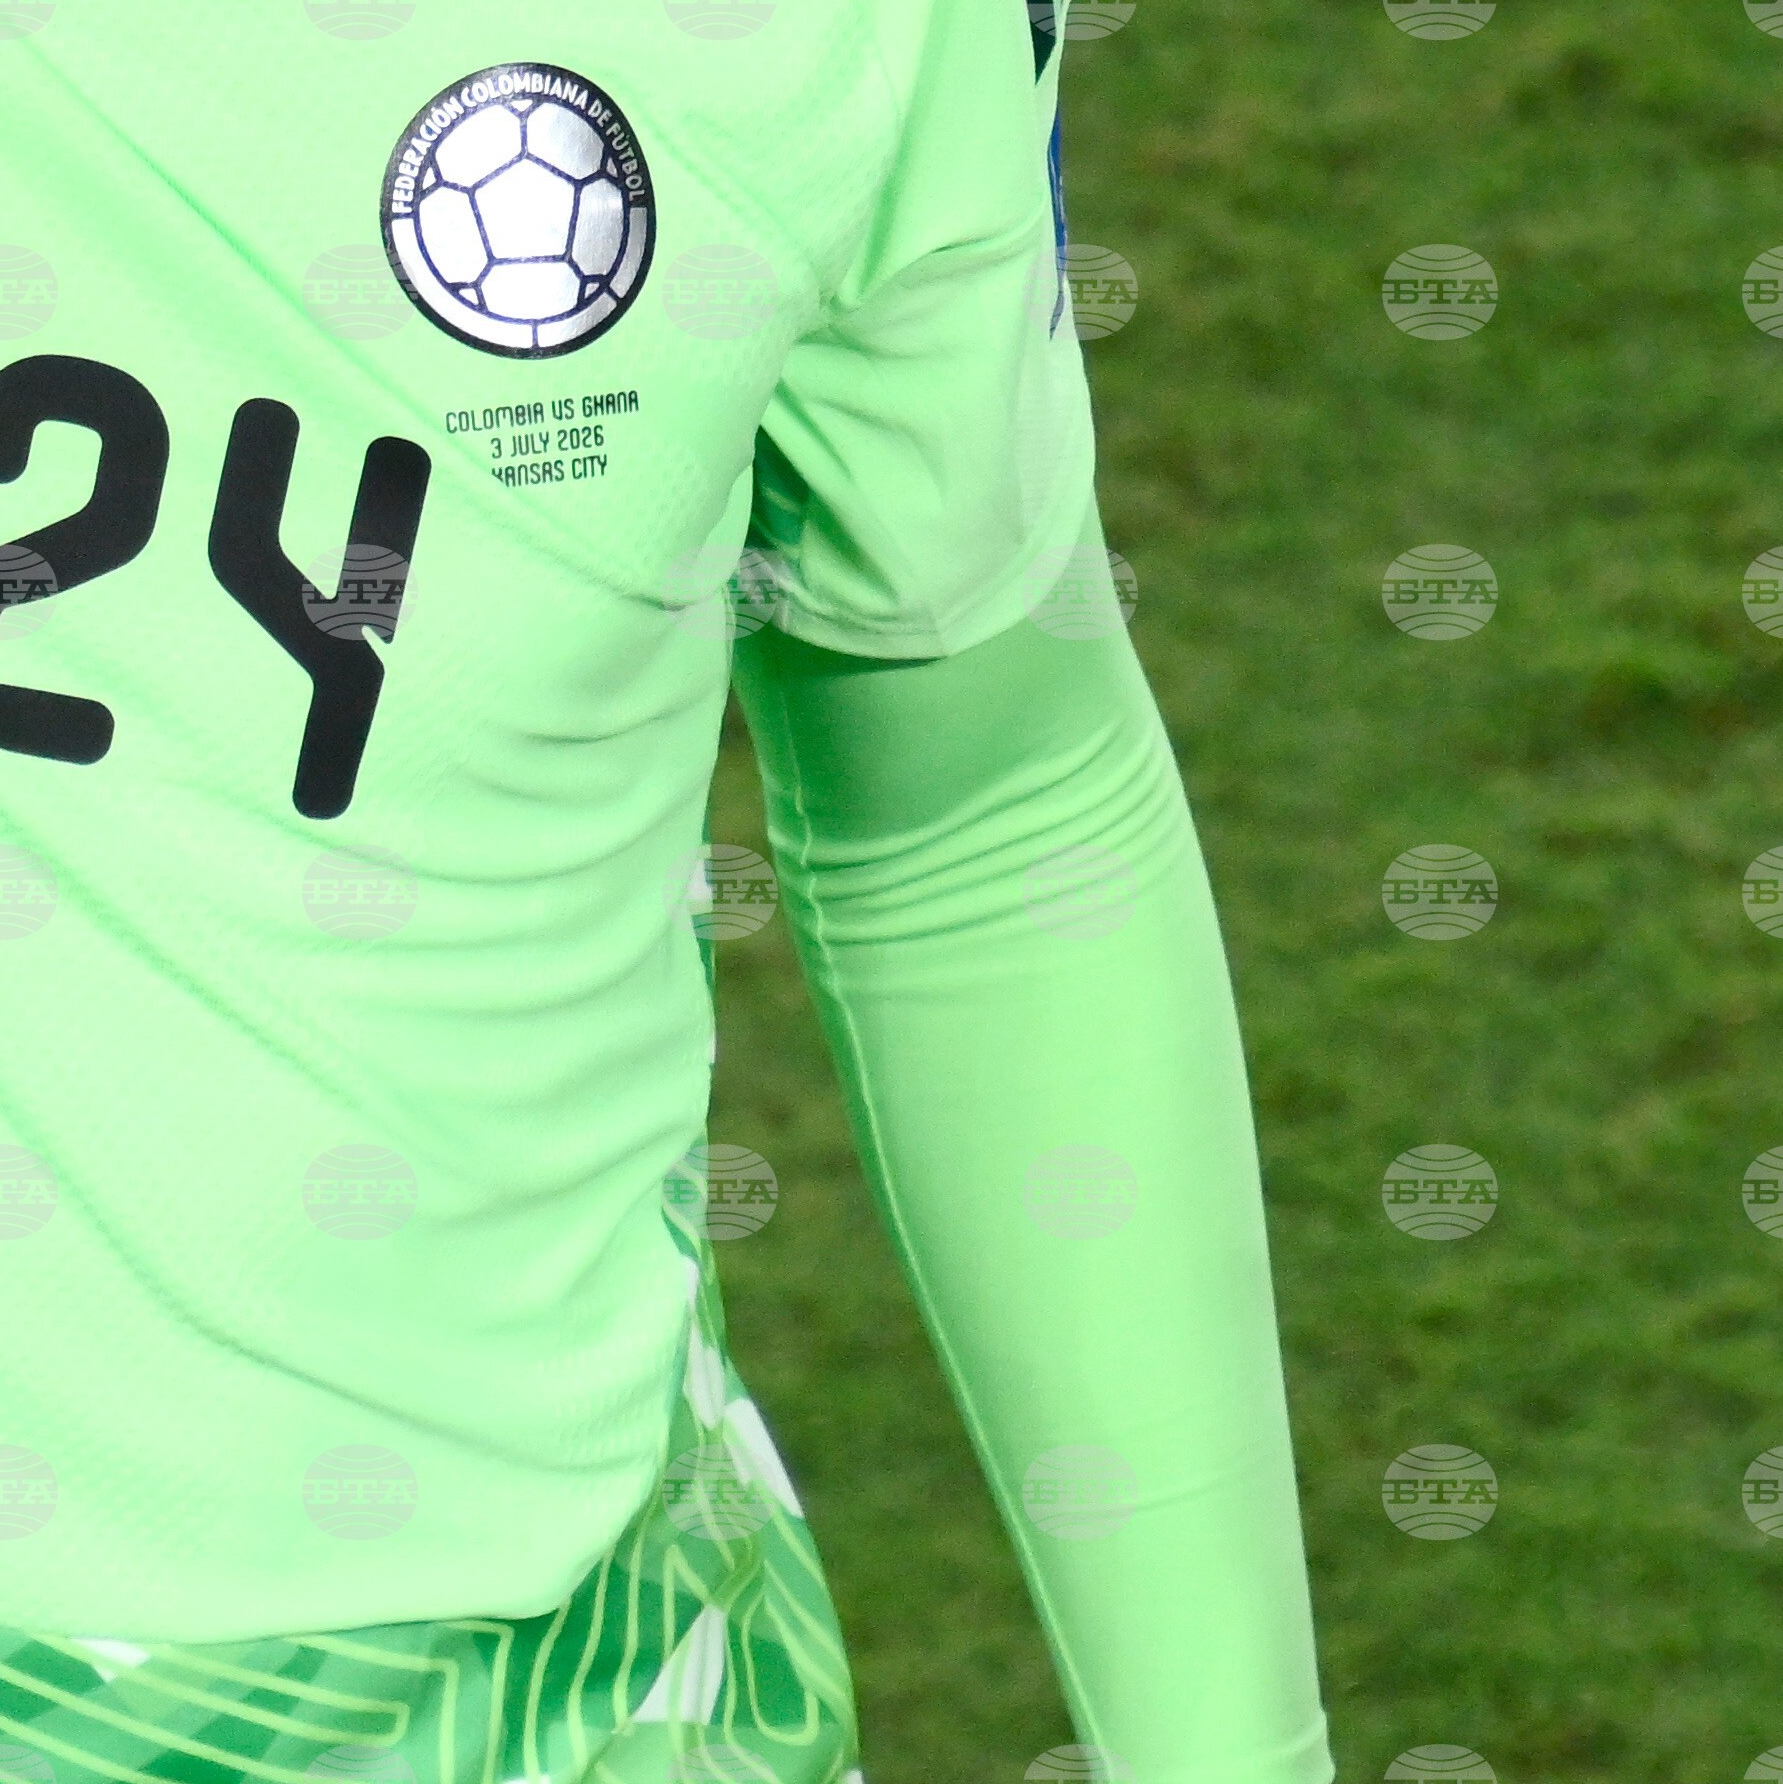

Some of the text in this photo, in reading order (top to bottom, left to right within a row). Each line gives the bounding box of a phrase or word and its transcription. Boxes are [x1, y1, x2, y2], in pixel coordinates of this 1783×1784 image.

[391, 72, 645, 214] FEDERACIÓN COLOMBIANA DE FÚTBOL
[445, 402, 545, 434] COLOMBIA
[581, 389, 640, 418] GHANA
[491, 424, 604, 459] 3 JULY 2026
[571, 453, 608, 480] CITY
